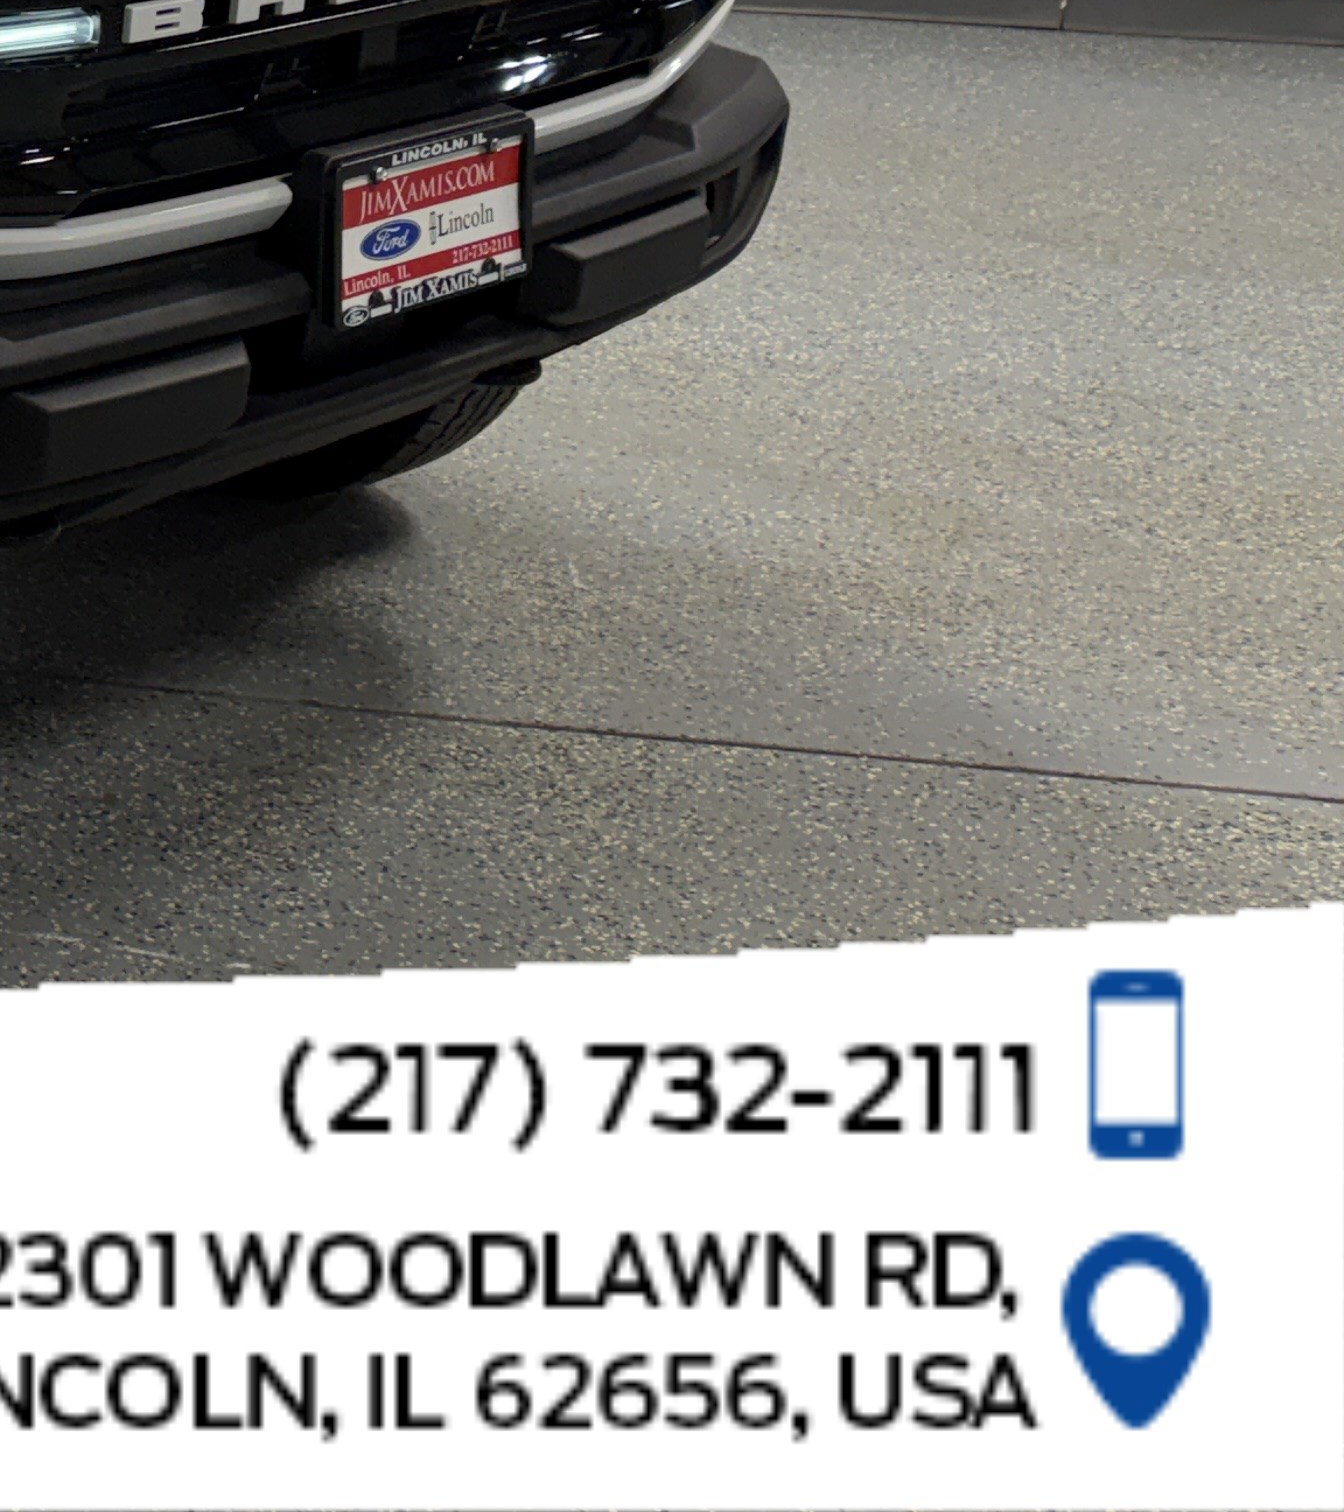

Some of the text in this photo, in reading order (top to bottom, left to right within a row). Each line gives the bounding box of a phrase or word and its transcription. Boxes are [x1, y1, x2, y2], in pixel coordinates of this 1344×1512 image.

[391, 131, 488, 167] LINCOLN, IL
[359, 160, 496, 224] JIMXAMIS.COM
[436, 203, 495, 237] Lincoln
[372, 225, 411, 255] Ford
[343, 265, 412, 296] Lincoln, IL
[393, 270, 479, 314] JIM XAMIS
